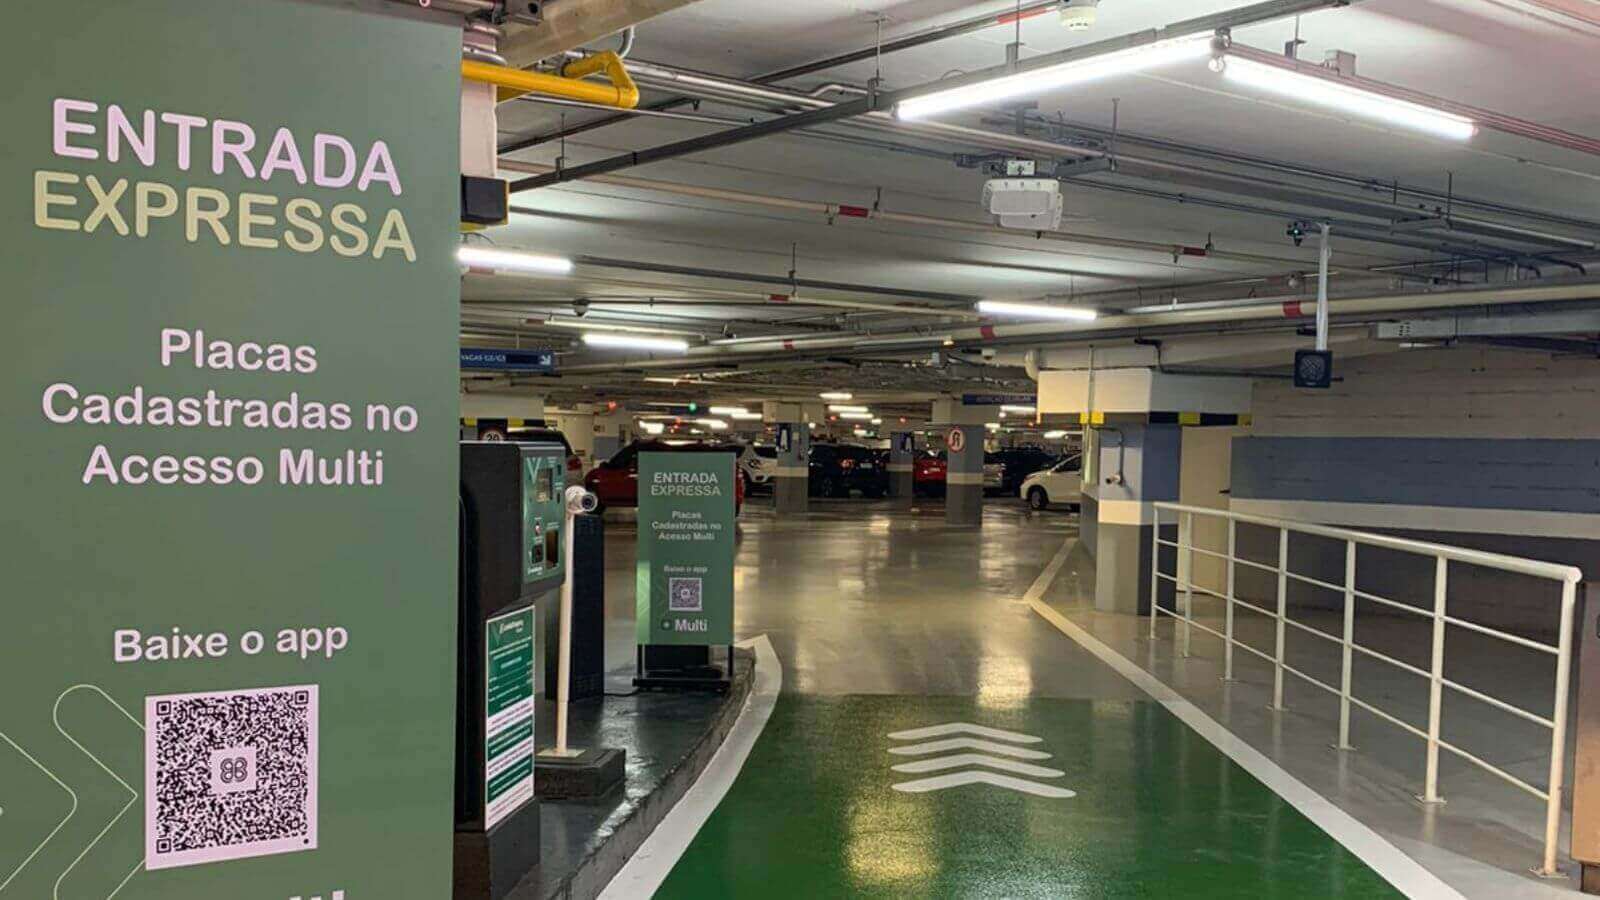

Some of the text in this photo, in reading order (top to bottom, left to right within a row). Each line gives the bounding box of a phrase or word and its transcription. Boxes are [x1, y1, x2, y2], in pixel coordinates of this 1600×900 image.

[53, 98, 402, 196] ENTRADA
[35, 171, 416, 262] EXPRESSA
[160, 328, 318, 373] Placas
[42, 383, 419, 432] Cadastradas no
[82, 444, 384, 486] Acesso Multi
[653, 472, 718, 484] ENTRADA
[651, 484, 721, 497] EXPRESSA
[651, 521, 708, 530] Cadastradas
[671, 511, 702, 519] Placas
[658, 532, 715, 541] Acesso Multi
[674, 619, 708, 632] Multi
[113, 626, 349, 662] Baixe o app
